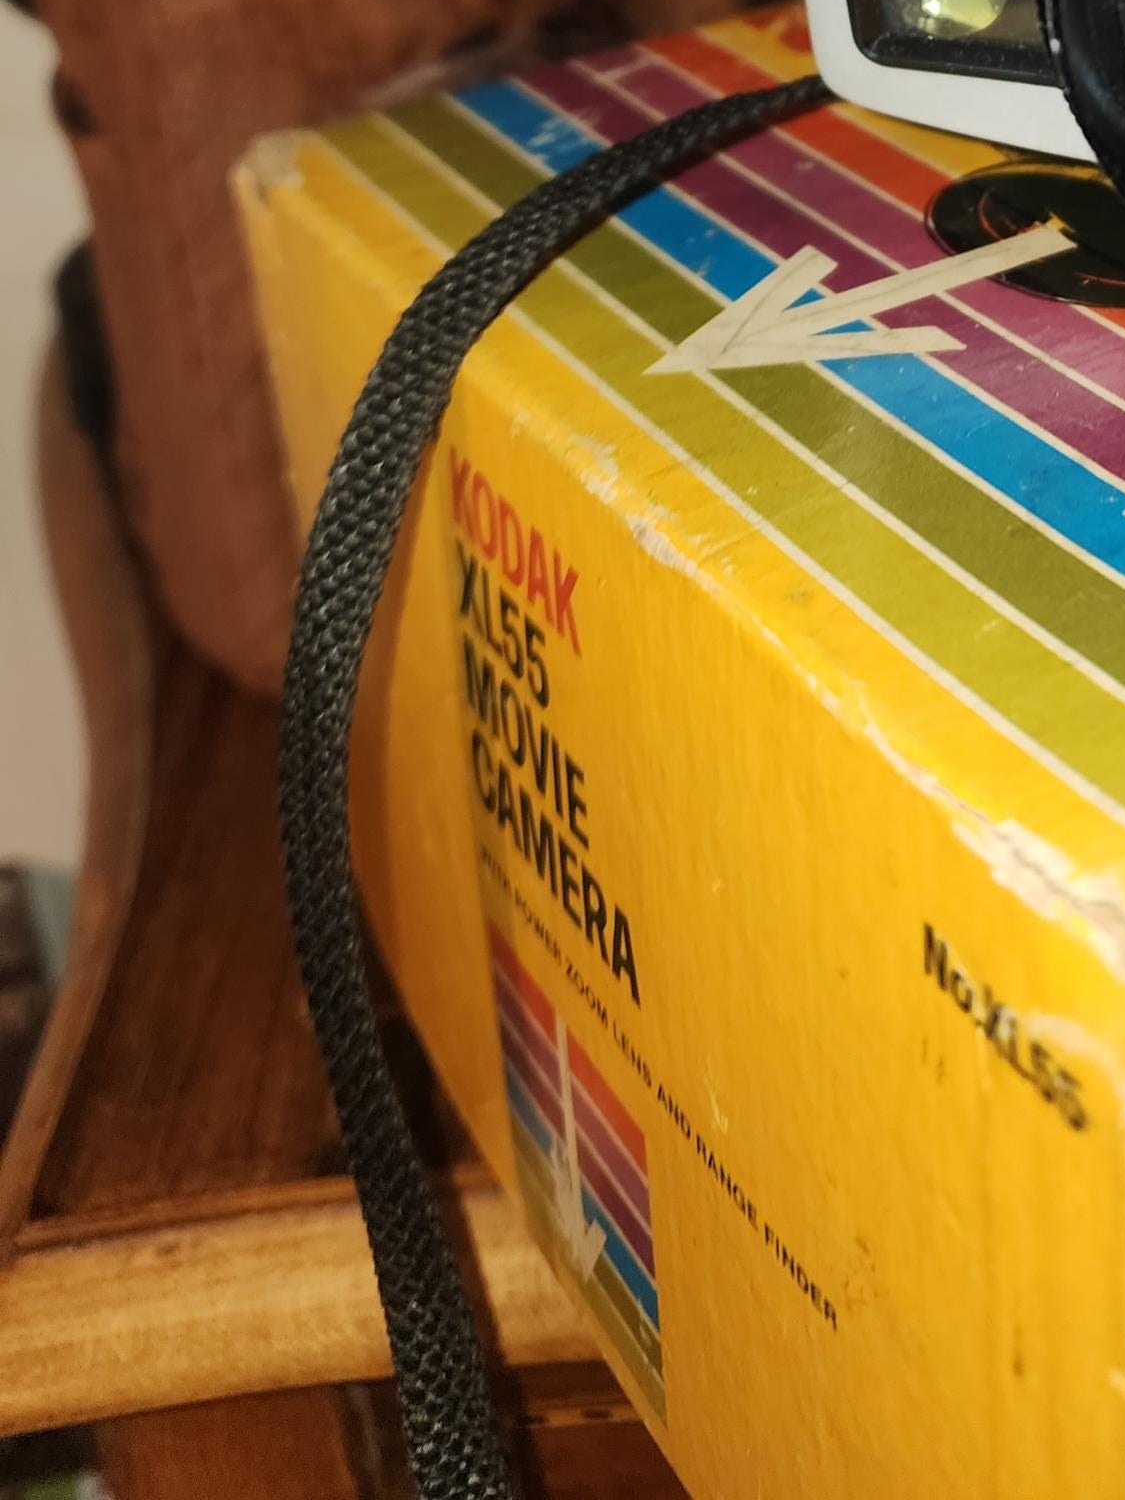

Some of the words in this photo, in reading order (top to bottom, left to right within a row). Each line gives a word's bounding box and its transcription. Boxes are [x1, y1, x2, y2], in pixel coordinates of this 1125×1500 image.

[449, 445, 581, 658] KODAK
[456, 538, 549, 709] XL55
[463, 642, 590, 850] MOVIE
[471, 726, 640, 1009] CAMERA
[513, 887, 561, 967] POWER
[564, 960, 608, 1029] ZOOM
[611, 1017, 652, 1088] LENS
[657, 1083, 691, 1140] AND
[696, 1133, 758, 1232] RANGE
[764, 1221, 837, 1332] FINDER
